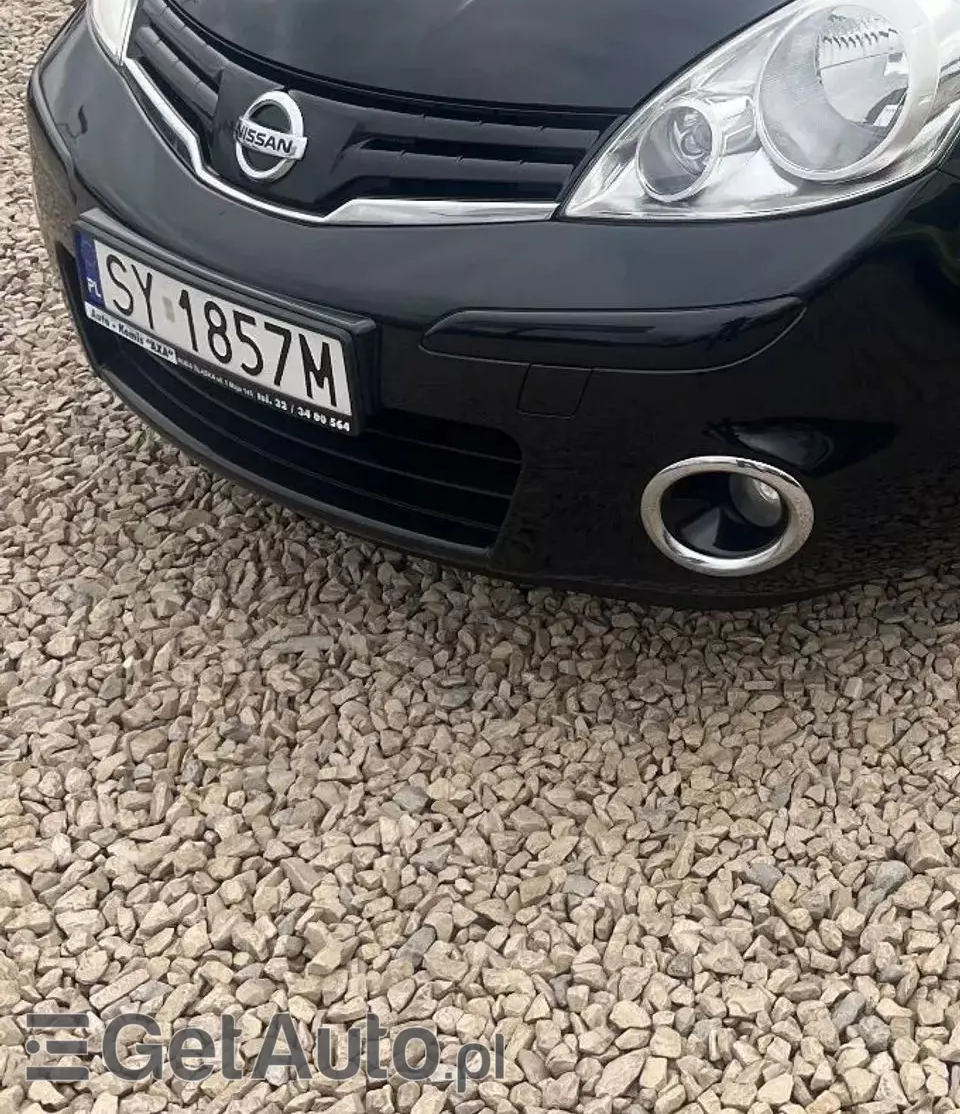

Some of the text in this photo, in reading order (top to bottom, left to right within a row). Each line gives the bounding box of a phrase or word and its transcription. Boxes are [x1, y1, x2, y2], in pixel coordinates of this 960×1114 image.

[236, 126, 294, 154] NISSAN
[87, 276, 101, 298] PL
[104, 252, 155, 330] SY
[178, 289, 338, 408] 1857M
